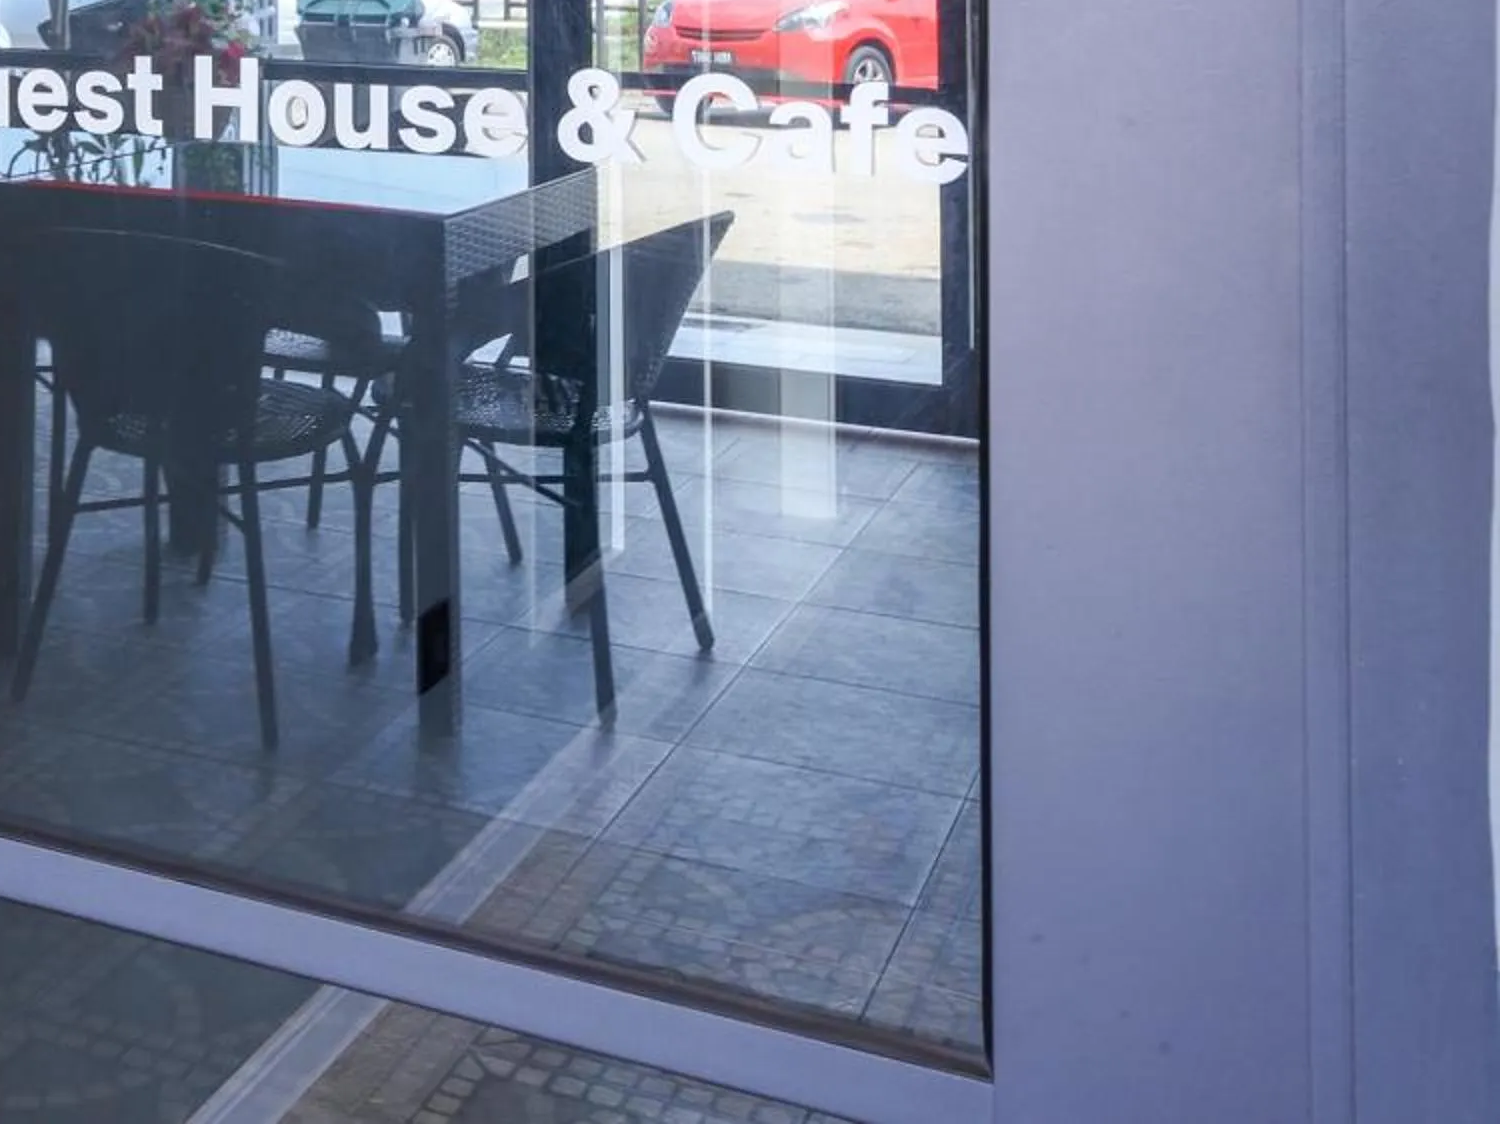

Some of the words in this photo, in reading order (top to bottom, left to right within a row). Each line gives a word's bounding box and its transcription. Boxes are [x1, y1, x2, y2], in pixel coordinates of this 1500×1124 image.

[194, 55, 529, 158] House
[556, 68, 643, 164] &
[672, 73, 969, 185] Cafe
